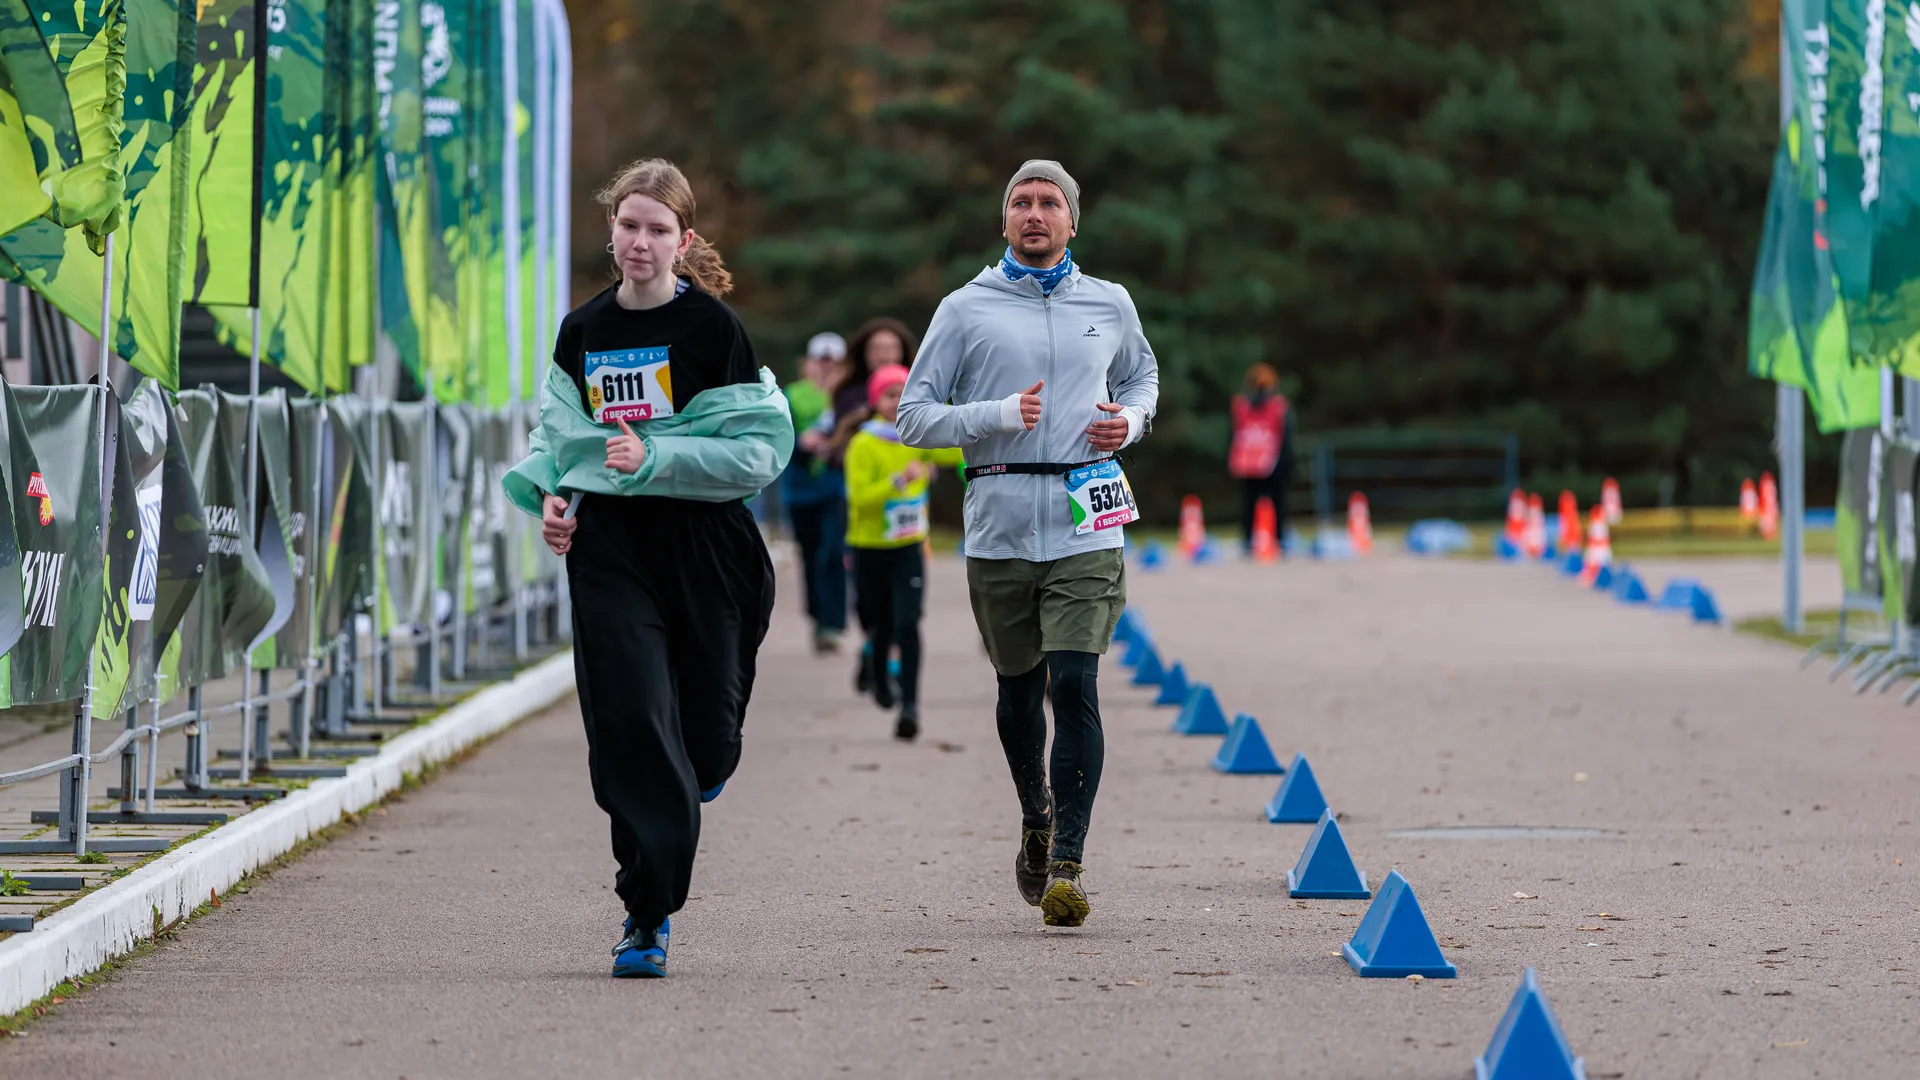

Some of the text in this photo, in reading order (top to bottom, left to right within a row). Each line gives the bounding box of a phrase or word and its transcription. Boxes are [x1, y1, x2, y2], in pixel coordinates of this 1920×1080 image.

[602, 372, 644, 403] 6111
[604, 411, 609, 420] 1
[609, 408, 647, 419] ВЕРСТА
[1089, 480, 1128, 513] 5321
[1103, 513, 1130, 525] ВЕРСТА
